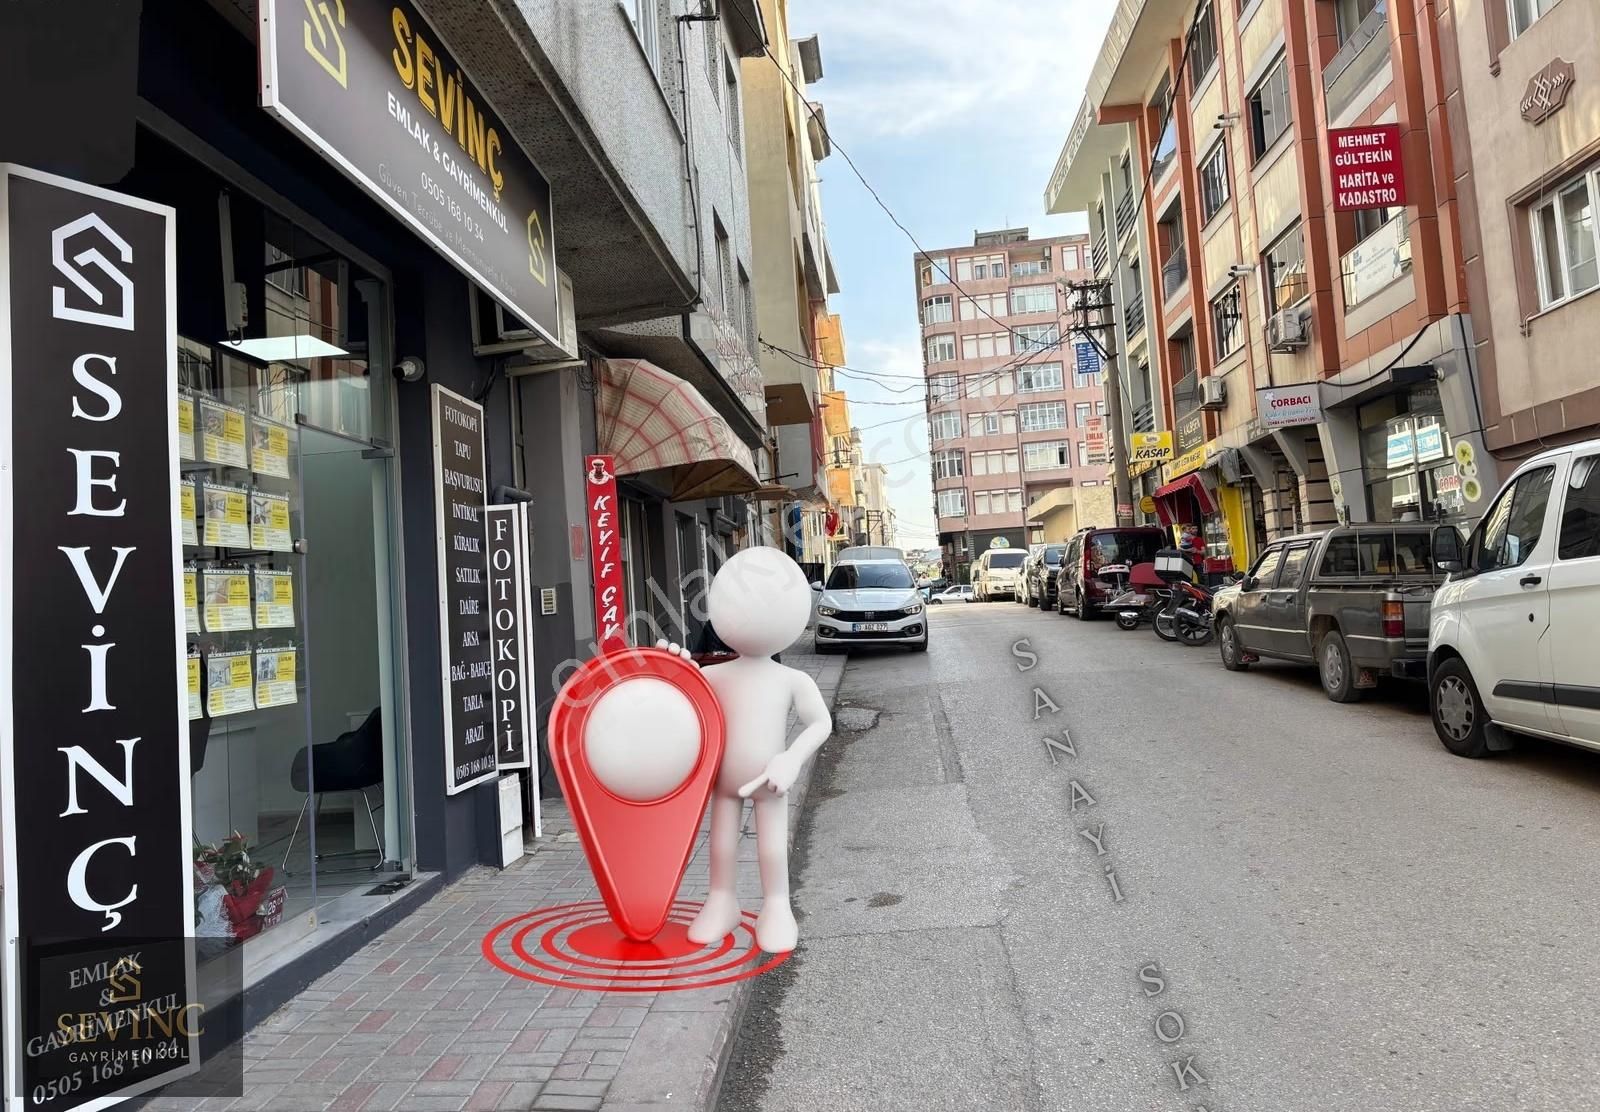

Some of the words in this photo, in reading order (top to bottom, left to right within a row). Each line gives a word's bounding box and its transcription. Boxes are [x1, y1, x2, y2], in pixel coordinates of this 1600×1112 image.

[391, 7, 504, 202] SEVİNÇ
[1338, 133, 1386, 148] MEHMET
[387, 91, 431, 153] EMLAK
[433, 141, 441, 165] &
[442, 152, 509, 234] GAYRİMENKUL
[1335, 147, 1393, 166] GÜLTEKİN
[1339, 170, 1380, 189] HARİTA
[1382, 173, 1394, 184] ve
[421, 172, 445, 206] 0505
[447, 196, 462, 222] 168
[464, 212, 473, 233] 10
[1339, 187, 1397, 207] KADASTRO
[1270, 396, 1312, 410] ÇORBACI
[444, 405, 478, 433] FOTOKOPİ
[454, 440, 471, 460] TAPU
[1135, 447, 1170, 459] KASAP
[444, 468, 483, 494] BAŞVURUSU
[452, 499, 479, 523] İNTİKAL
[453, 532, 480, 553] KİRALIK
[594, 495, 615, 579] KEYİF
[456, 566, 480, 583] SATILIK
[460, 596, 480, 615] DAİRE
[601, 586, 621, 641] ÇAY
[57, 353, 142, 932] SEVİNÇ
[462, 631, 480, 647] ARSA
[493, 519, 516, 752] FOTOKOPİ
[451, 661, 466, 682] BAĞ
[470, 661, 492, 680] BAHÇE
[463, 693, 484, 713] TARLA
[465, 721, 485, 745] ARAZİ
[456, 763, 470, 780] 0505
[69, 951, 144, 990] EMLAK
[26, 993, 182, 1058] GAYRİMENKUL
[32, 1071, 83, 1105] 0505
[92, 1058, 124, 1085] 168
